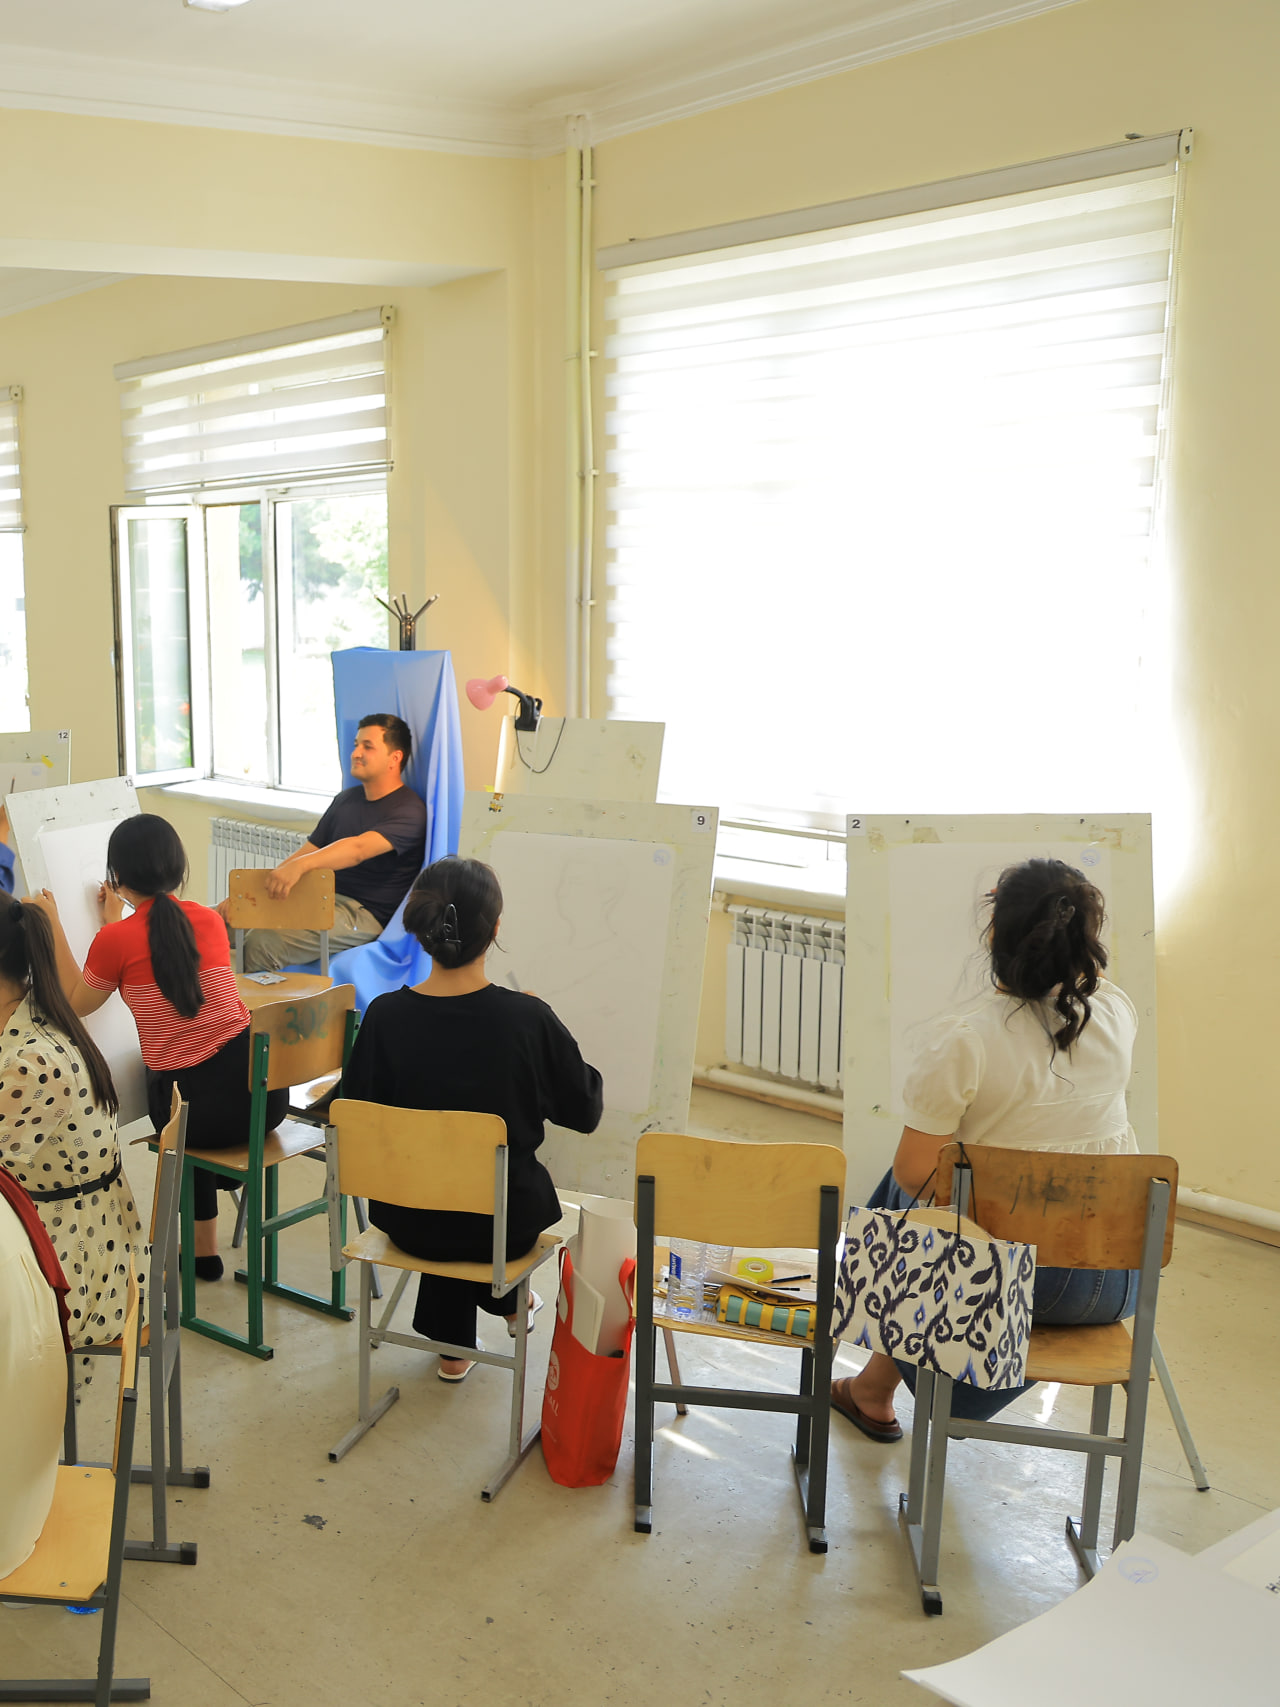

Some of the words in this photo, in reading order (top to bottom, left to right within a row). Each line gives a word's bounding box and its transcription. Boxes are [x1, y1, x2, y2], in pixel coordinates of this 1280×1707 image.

[125, 779, 134, 787] 13
[697, 815, 705, 826] 9
[852, 819, 861, 829] 2
